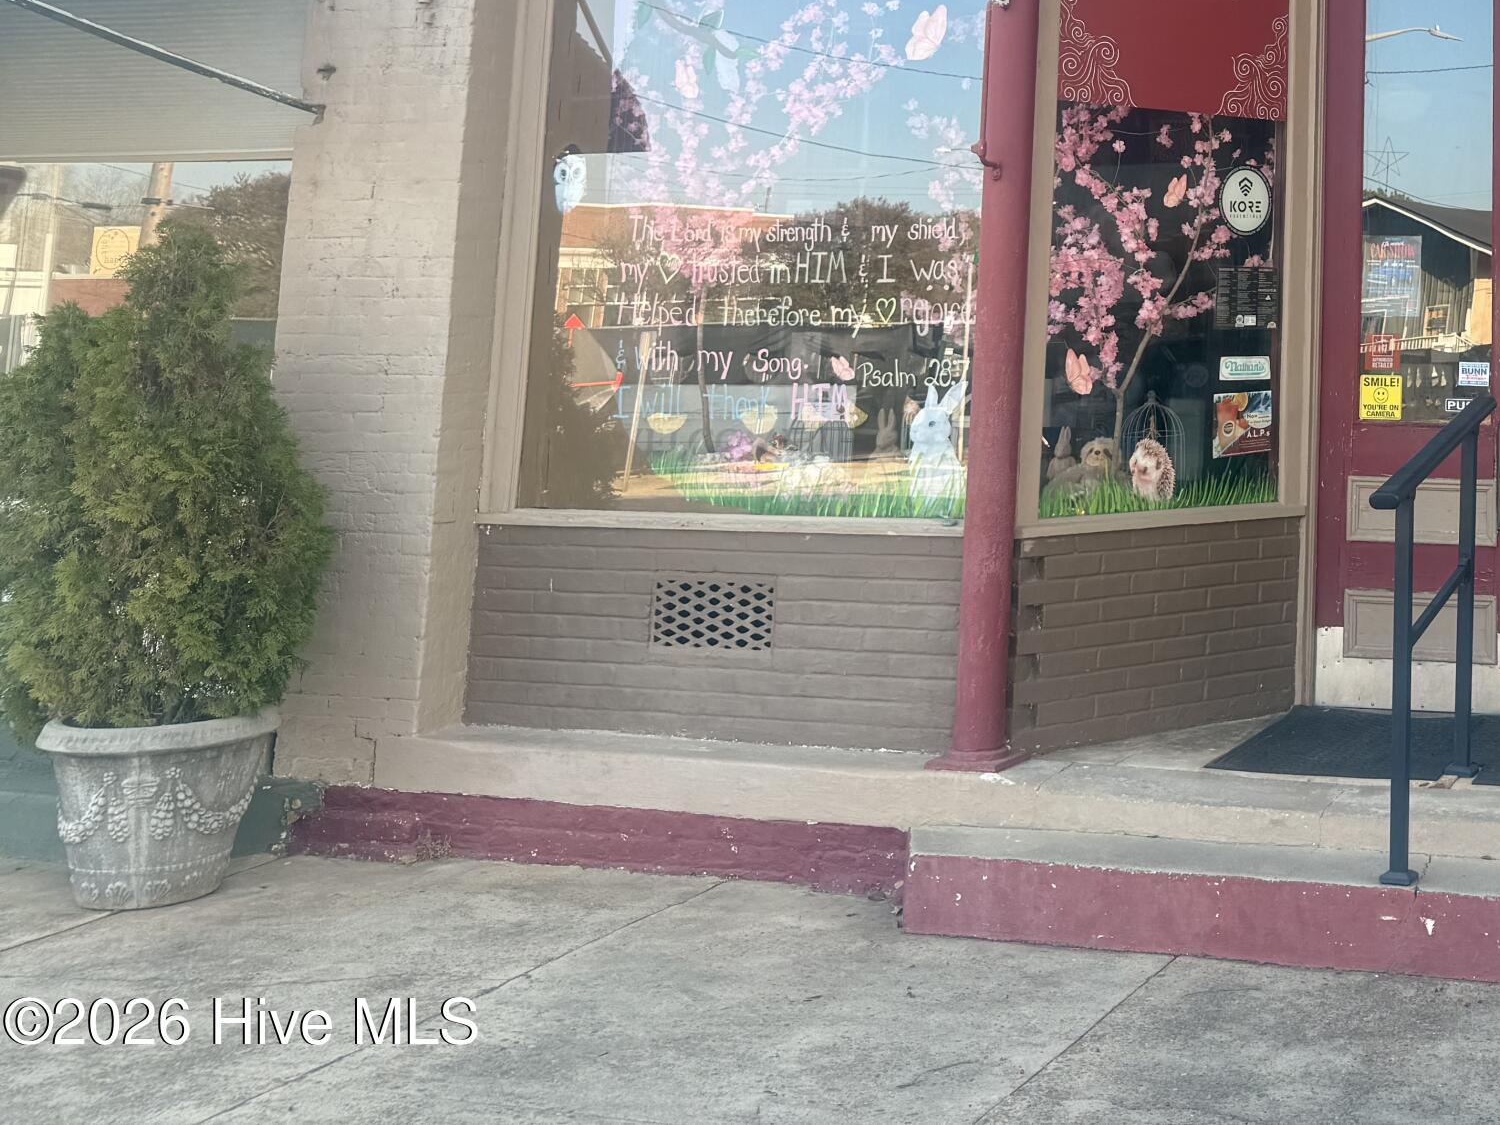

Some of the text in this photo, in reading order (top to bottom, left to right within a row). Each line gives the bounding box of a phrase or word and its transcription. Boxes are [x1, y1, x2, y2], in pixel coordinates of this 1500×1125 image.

[1229, 200, 1262, 213] KORE
[766, 218, 832, 252] strength
[871, 224, 899, 249] my
[795, 250, 847, 284] HIM
[876, 254, 896, 283] I
[697, 349, 734, 380] my
[857, 358, 917, 387] Psalm
[1461, 367, 1487, 375] BUNN
[1363, 377, 1399, 387] SMILE!
